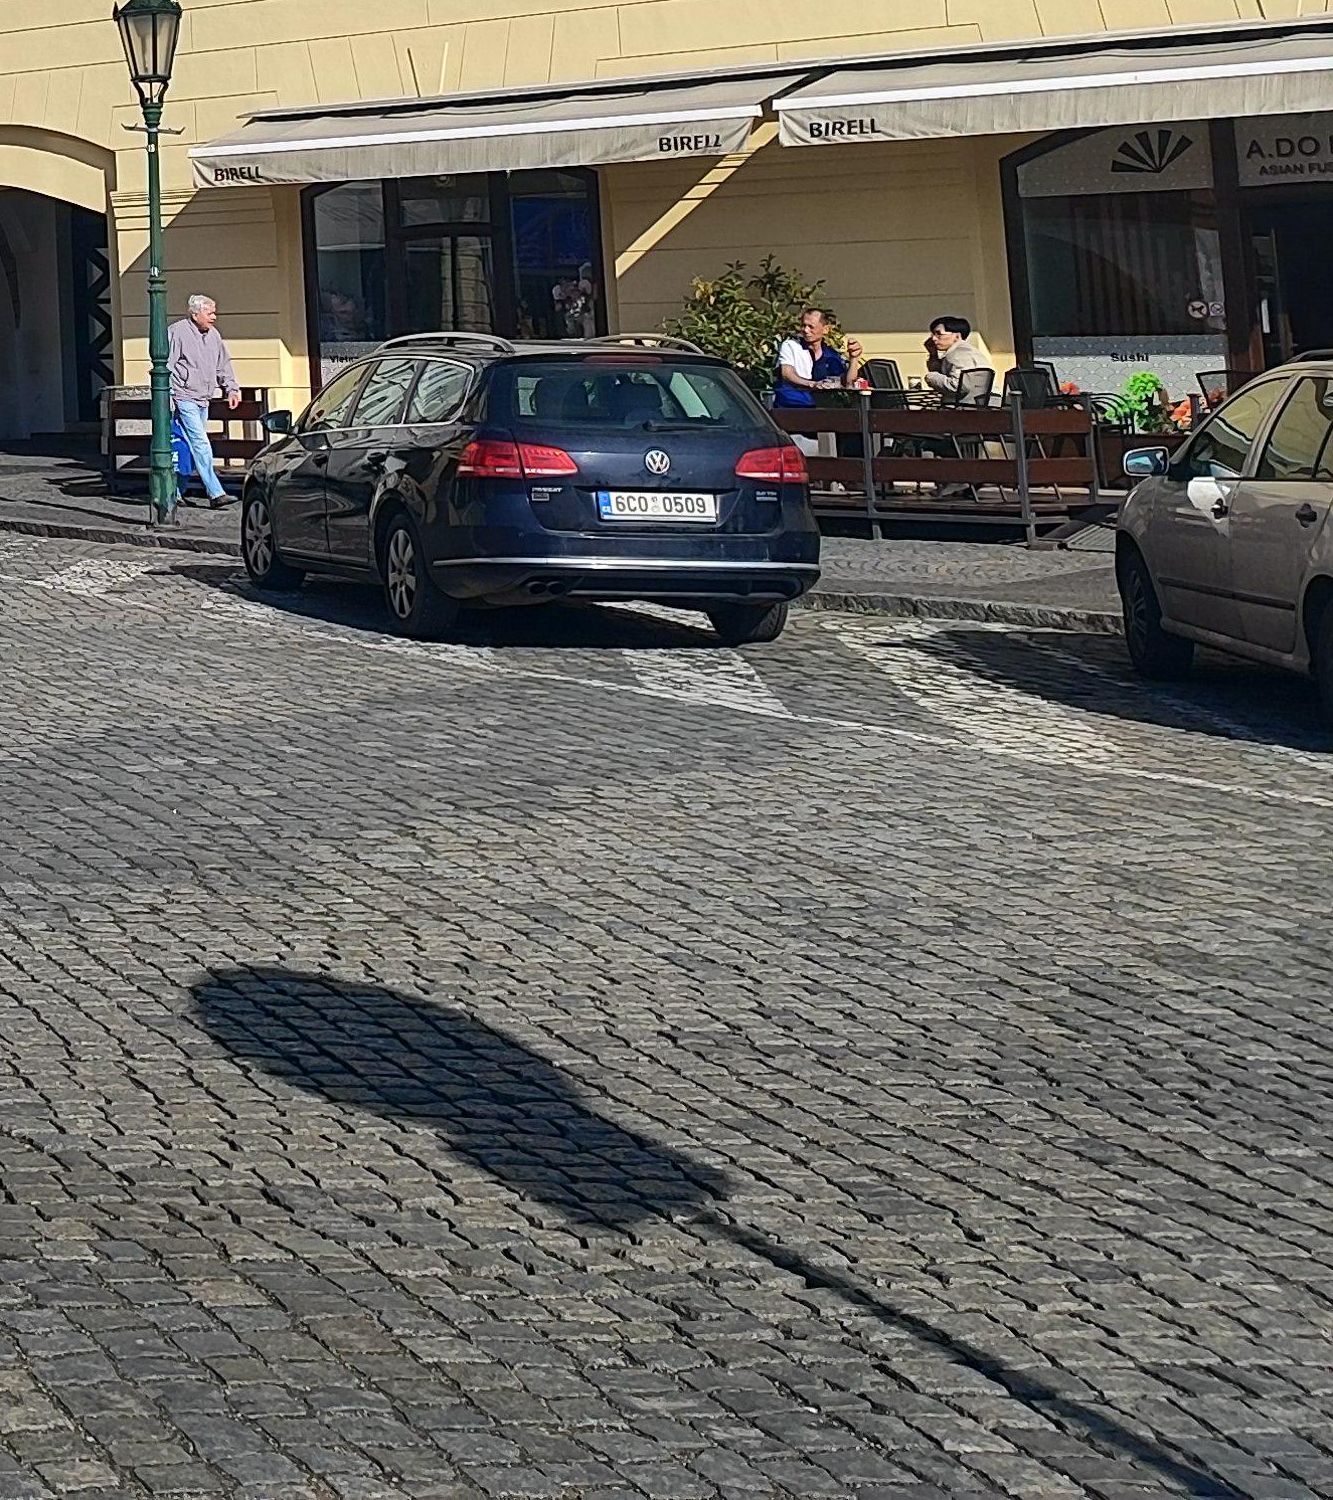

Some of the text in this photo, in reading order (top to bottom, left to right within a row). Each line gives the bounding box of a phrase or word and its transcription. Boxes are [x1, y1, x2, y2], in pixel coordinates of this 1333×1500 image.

[808, 117, 882, 140] BIRELL
[658, 133, 723, 153] BIRELL
[213, 164, 264, 183] BIRELL
[1110, 352, 1150, 363] Sushi
[662, 496, 707, 514] 0509
